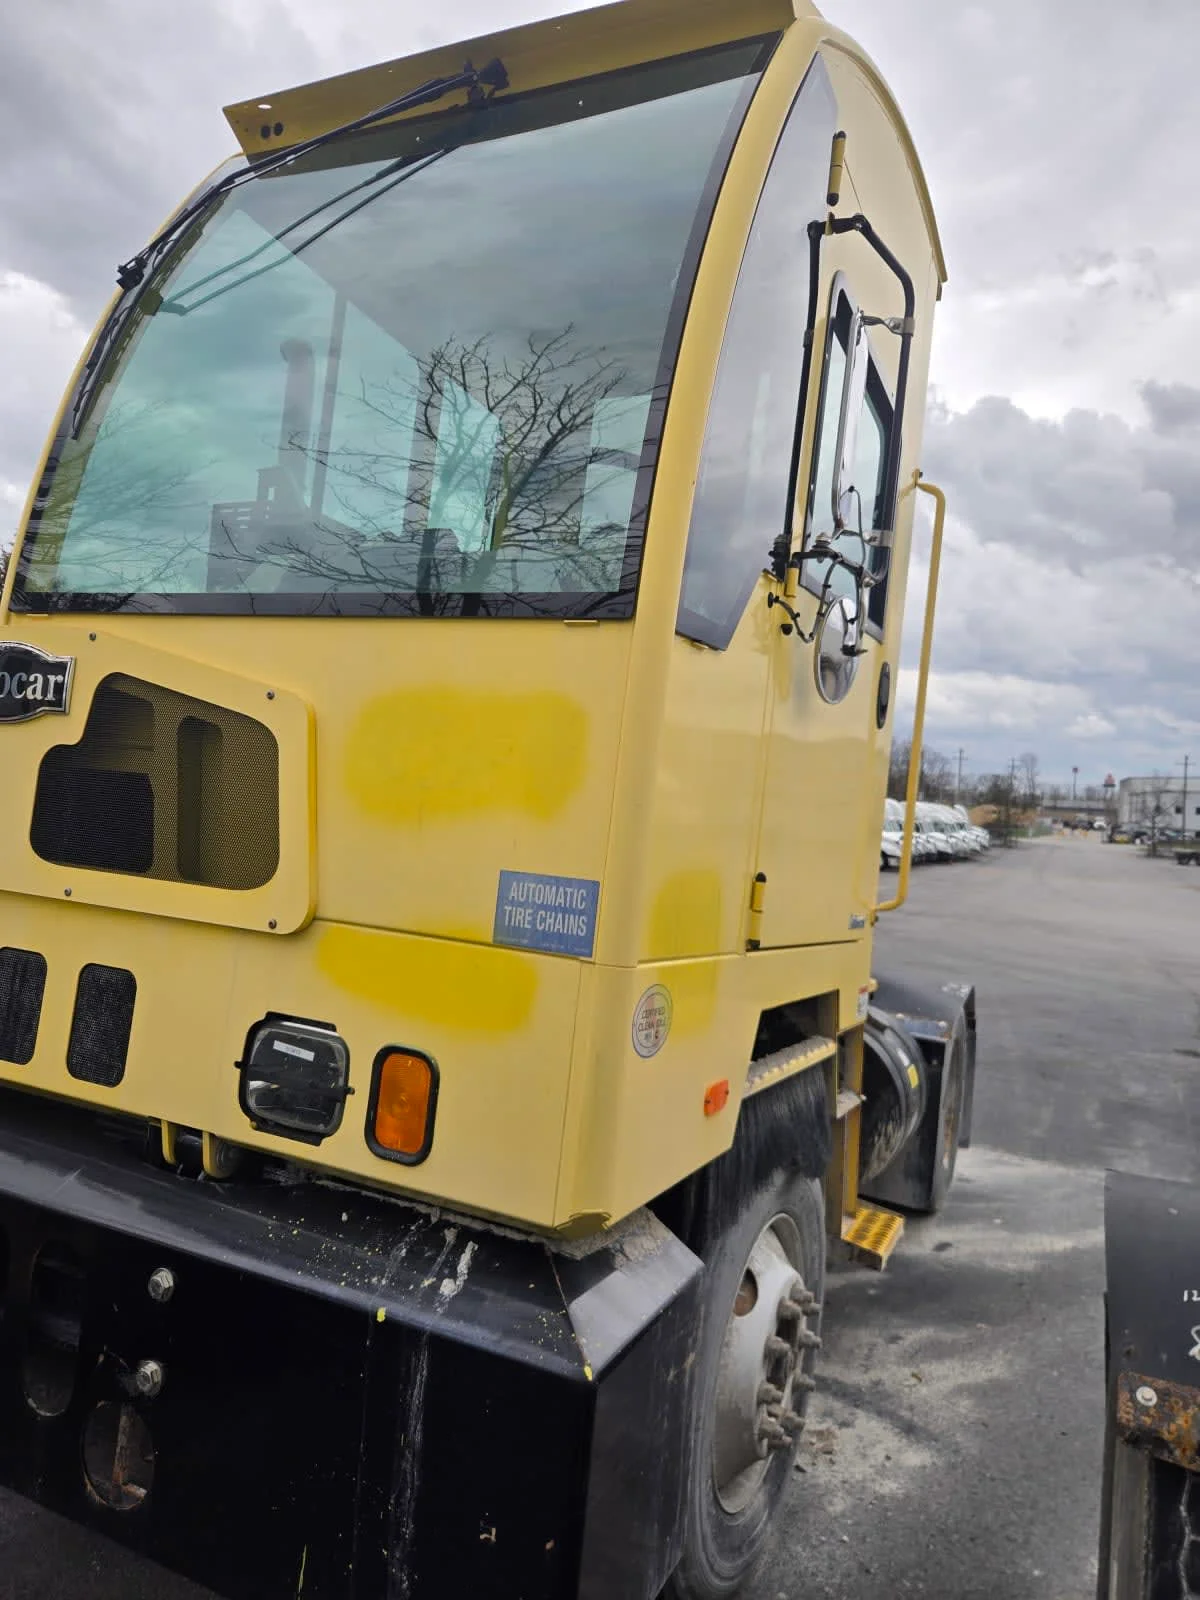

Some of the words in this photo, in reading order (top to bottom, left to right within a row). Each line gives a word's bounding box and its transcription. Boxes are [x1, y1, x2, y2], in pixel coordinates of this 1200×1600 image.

[509, 881, 587, 910] AUTOMATIC
[503, 905, 534, 929] TIRE
[535, 910, 588, 937] CHAINS
